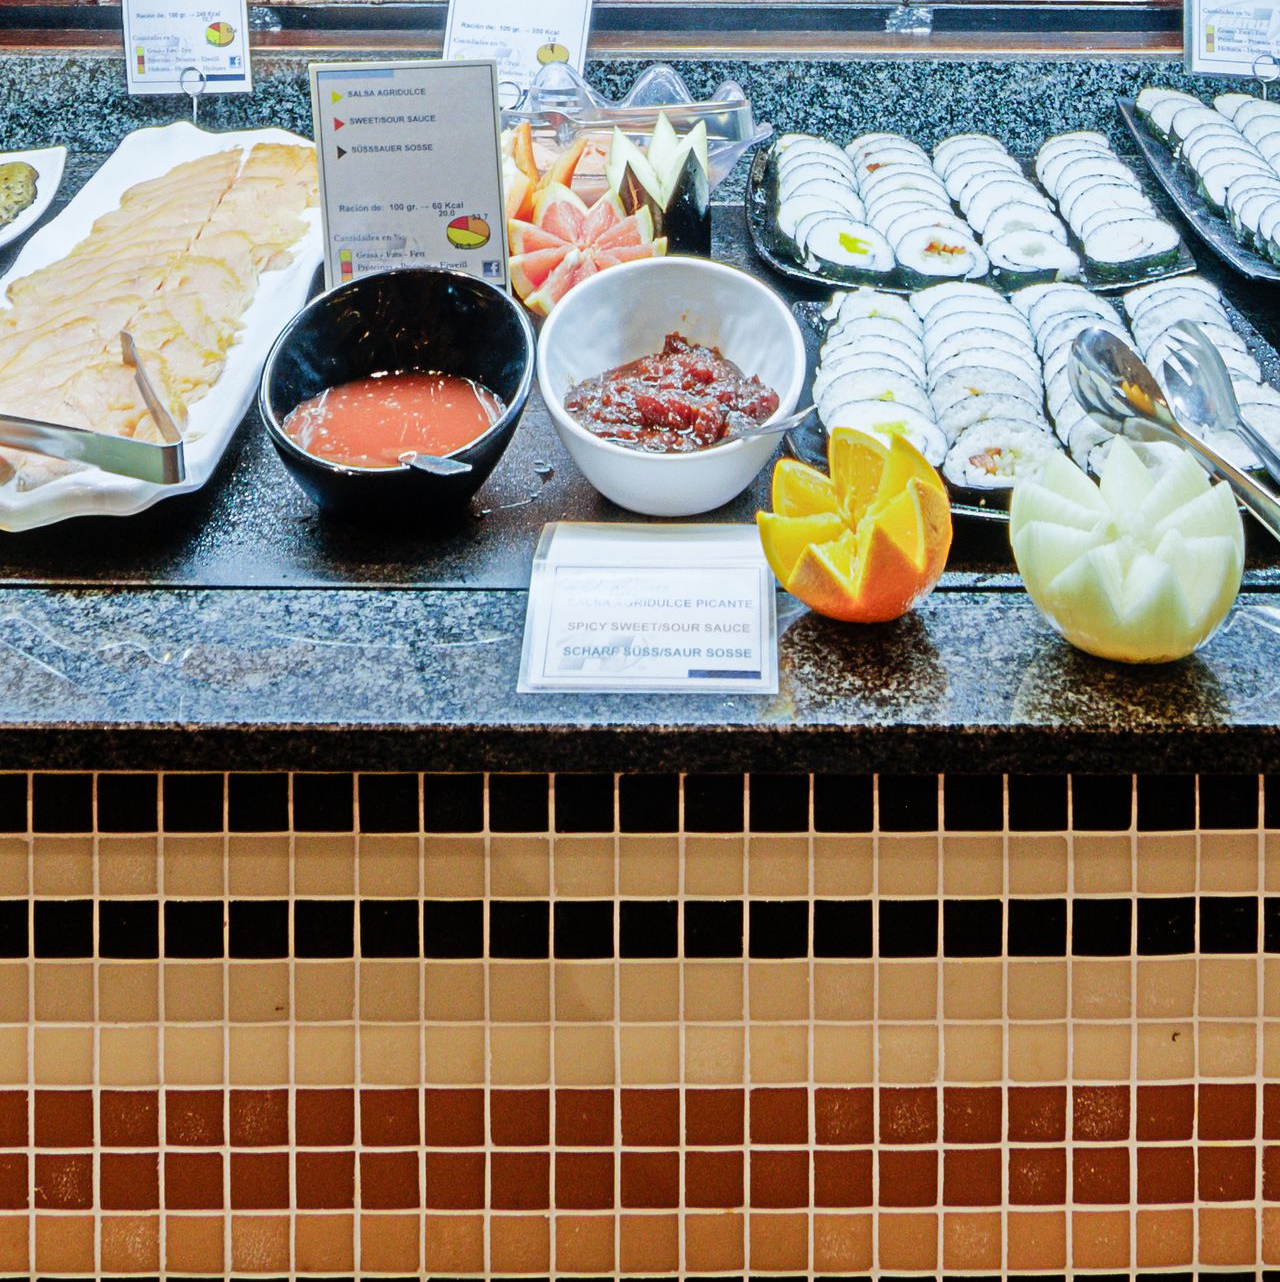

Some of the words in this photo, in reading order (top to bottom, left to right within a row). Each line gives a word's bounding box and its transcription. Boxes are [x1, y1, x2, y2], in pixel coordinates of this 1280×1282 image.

[348, 90, 375, 98] SALSA
[377, 88, 426, 96] AGRIDULCE
[696, 599, 753, 609] PICANTE
[567, 622, 607, 631] SPICY
[610, 622, 701, 633] SWEET/SOUR
[704, 623, 751, 633] SAUCE
[563, 646, 621, 656] SCHARF
[705, 648, 753, 658] SOSSE
